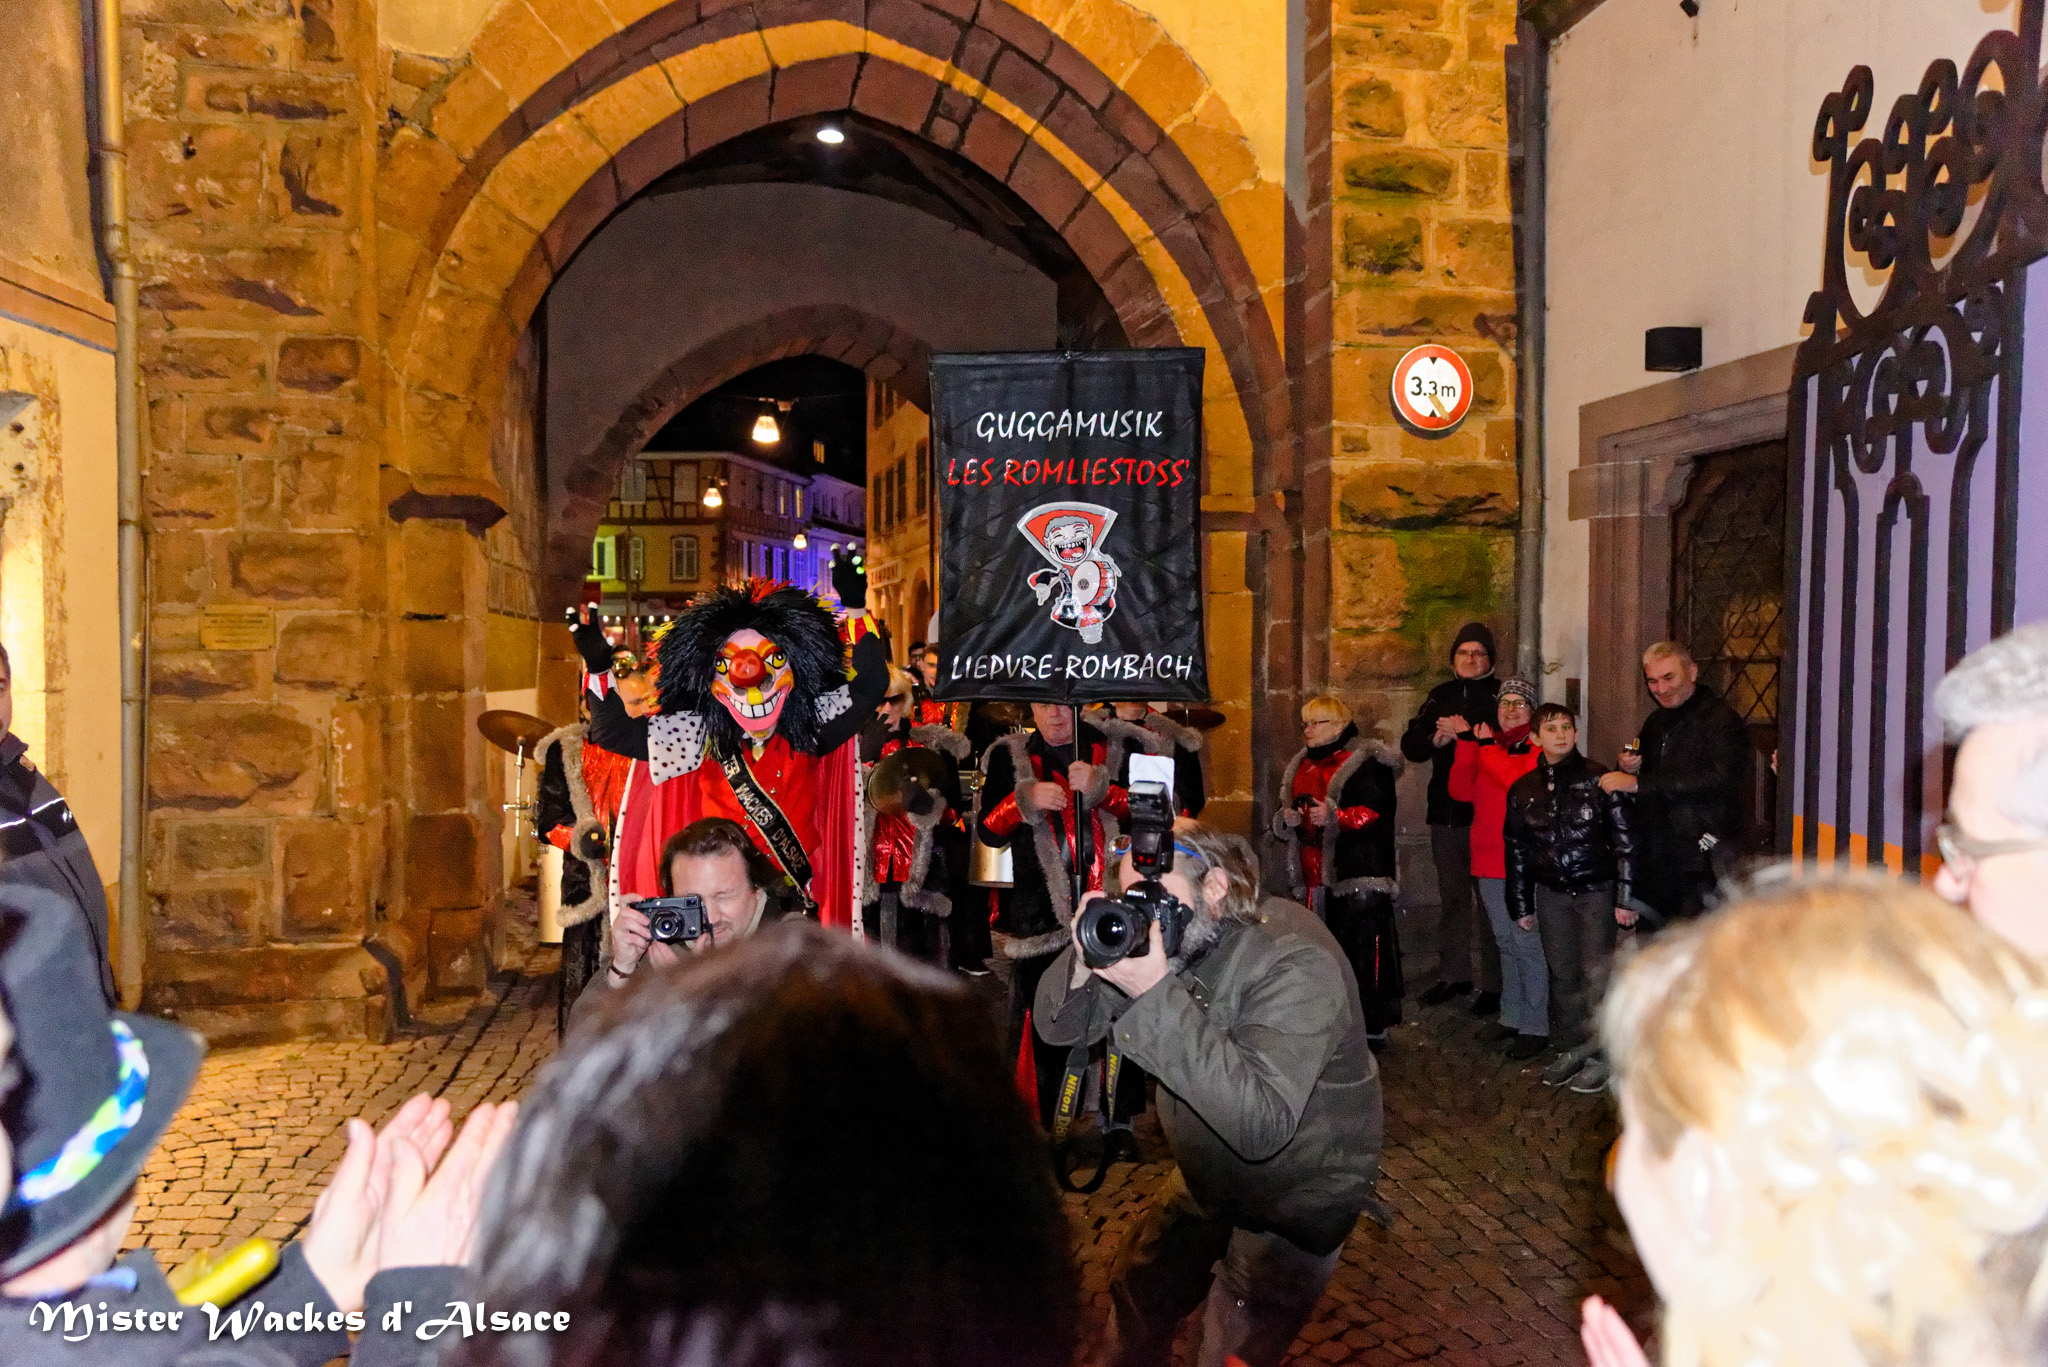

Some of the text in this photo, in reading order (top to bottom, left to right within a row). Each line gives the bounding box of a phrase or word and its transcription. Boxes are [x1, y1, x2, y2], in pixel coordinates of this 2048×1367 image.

[976, 408, 1163, 442] GUGGAMUSIK
[948, 457, 1191, 488] LES ROMLIESTOSS'
[951, 652, 1193, 681] LIEPVRE-ROMBACH
[734, 782, 774, 826] WACKES
[771, 827, 807, 874] D'ALSACE
[1107, 1053, 1118, 1094] Nikon
[1061, 1073, 1078, 1114] Nikon
